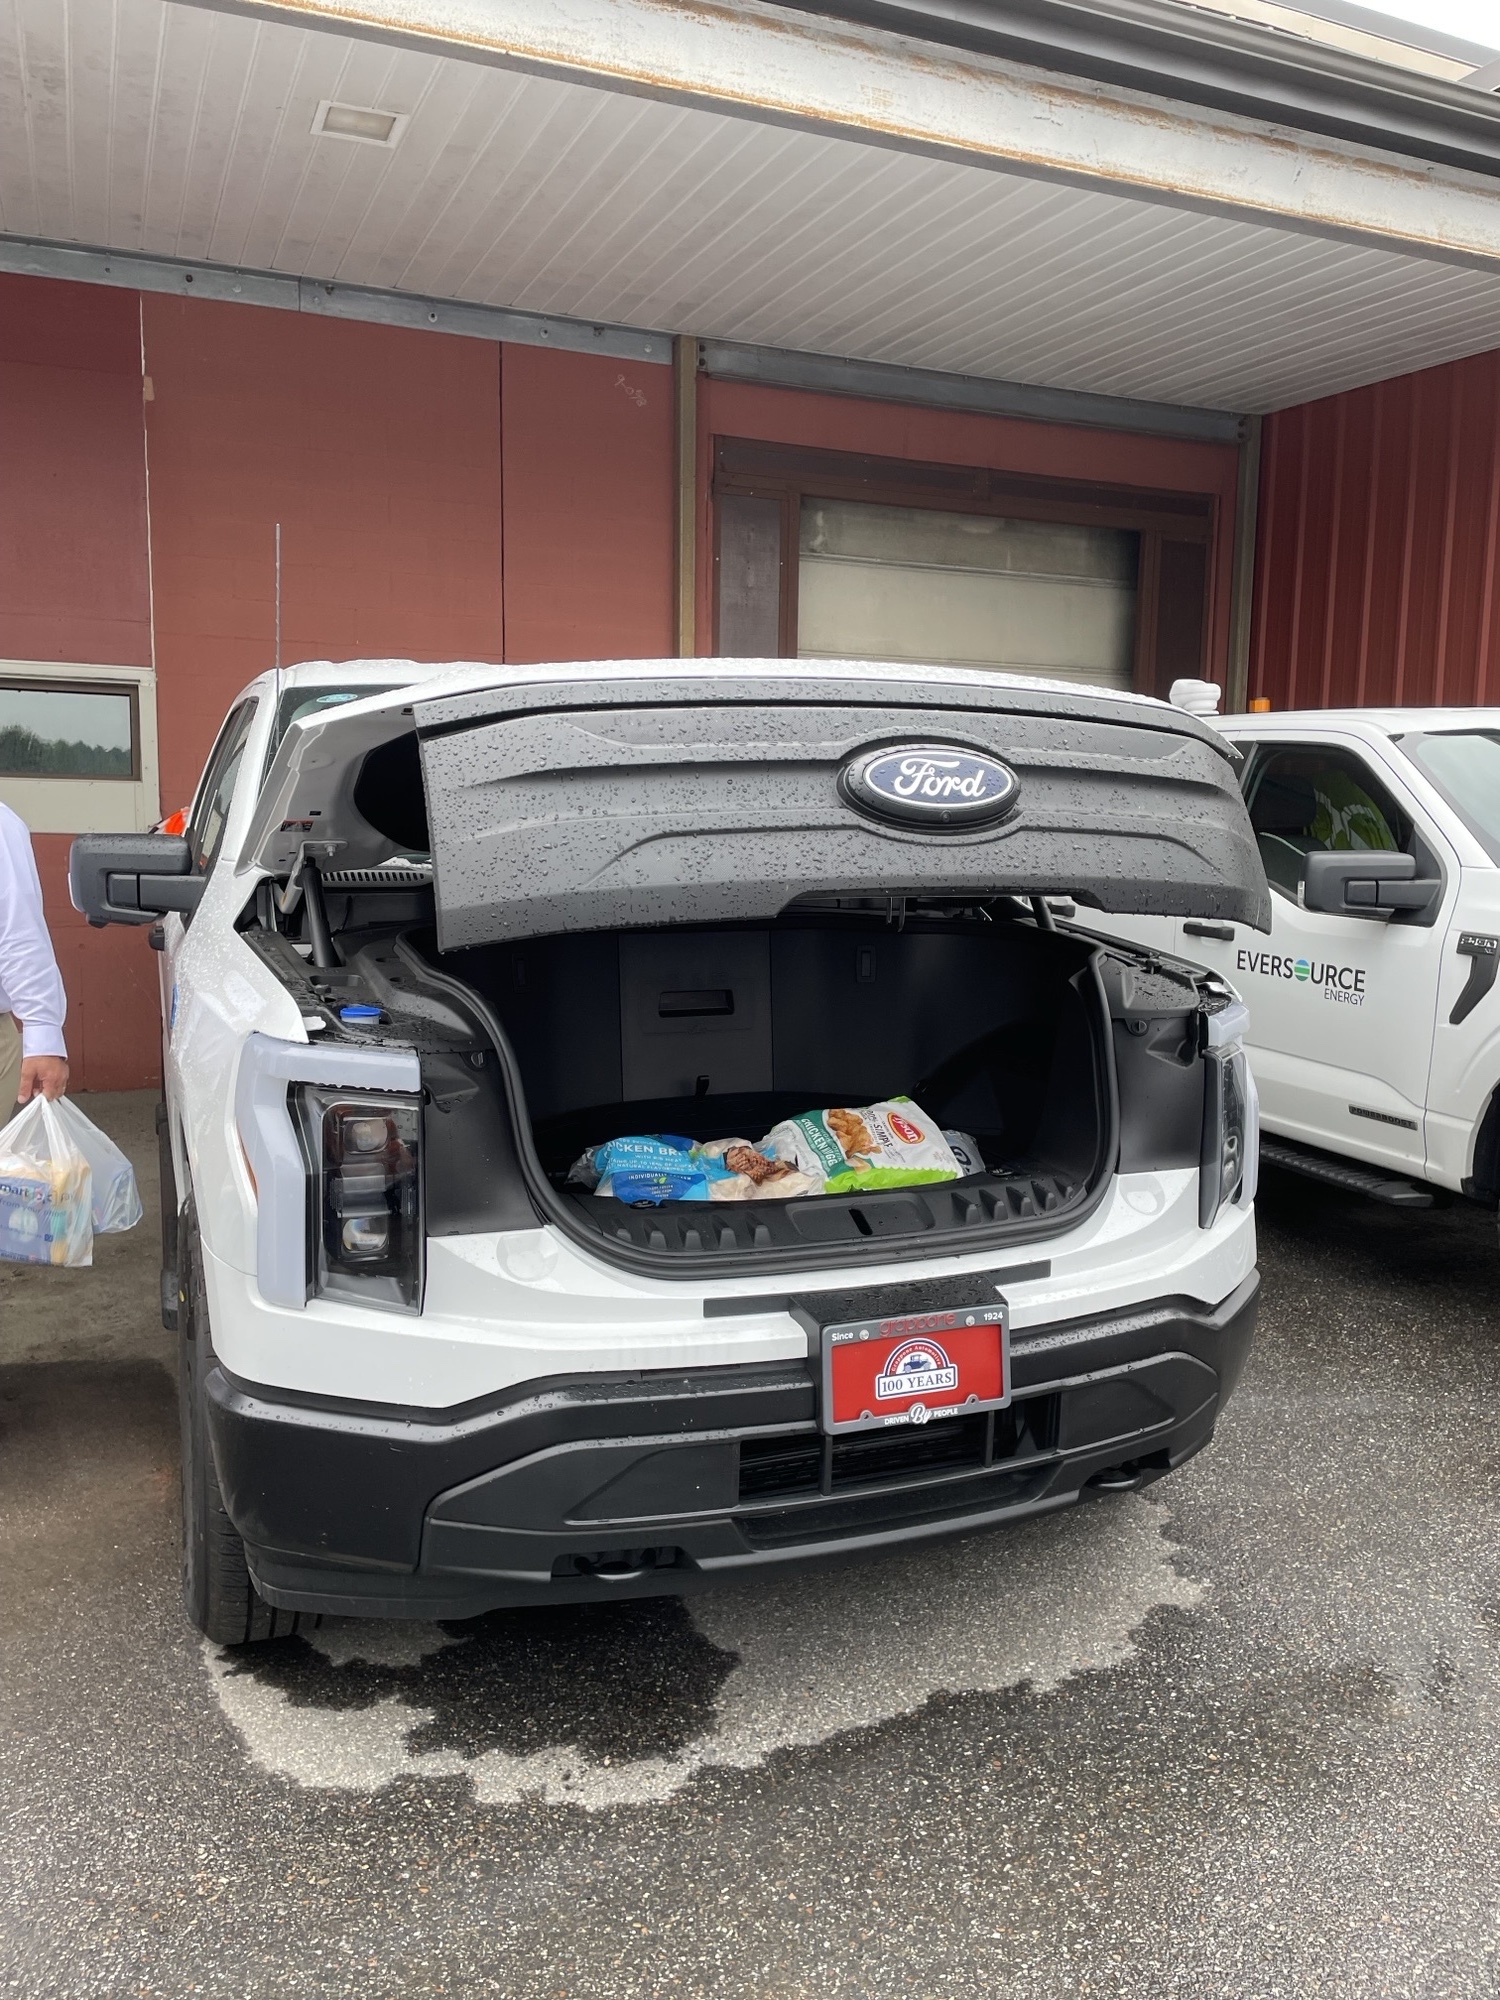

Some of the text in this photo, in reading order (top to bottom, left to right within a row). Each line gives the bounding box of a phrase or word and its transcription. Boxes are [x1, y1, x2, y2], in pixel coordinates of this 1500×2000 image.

[894, 757, 987, 798] Ford
[1323, 988, 1365, 1006] ENERGY
[801, 1118, 829, 1151] CHICKEN
[892, 1115, 919, 1143] Tyson
[628, 1172, 668, 1180] INDIVIDUALLY
[831, 1311, 1004, 1342] Since grappone 1924
[891, 1345, 942, 1372] Grappone Automotive
[881, 1372, 953, 1393] 100 YEARS
[884, 1405, 959, 1426] DRIVEN By PEOPLE
